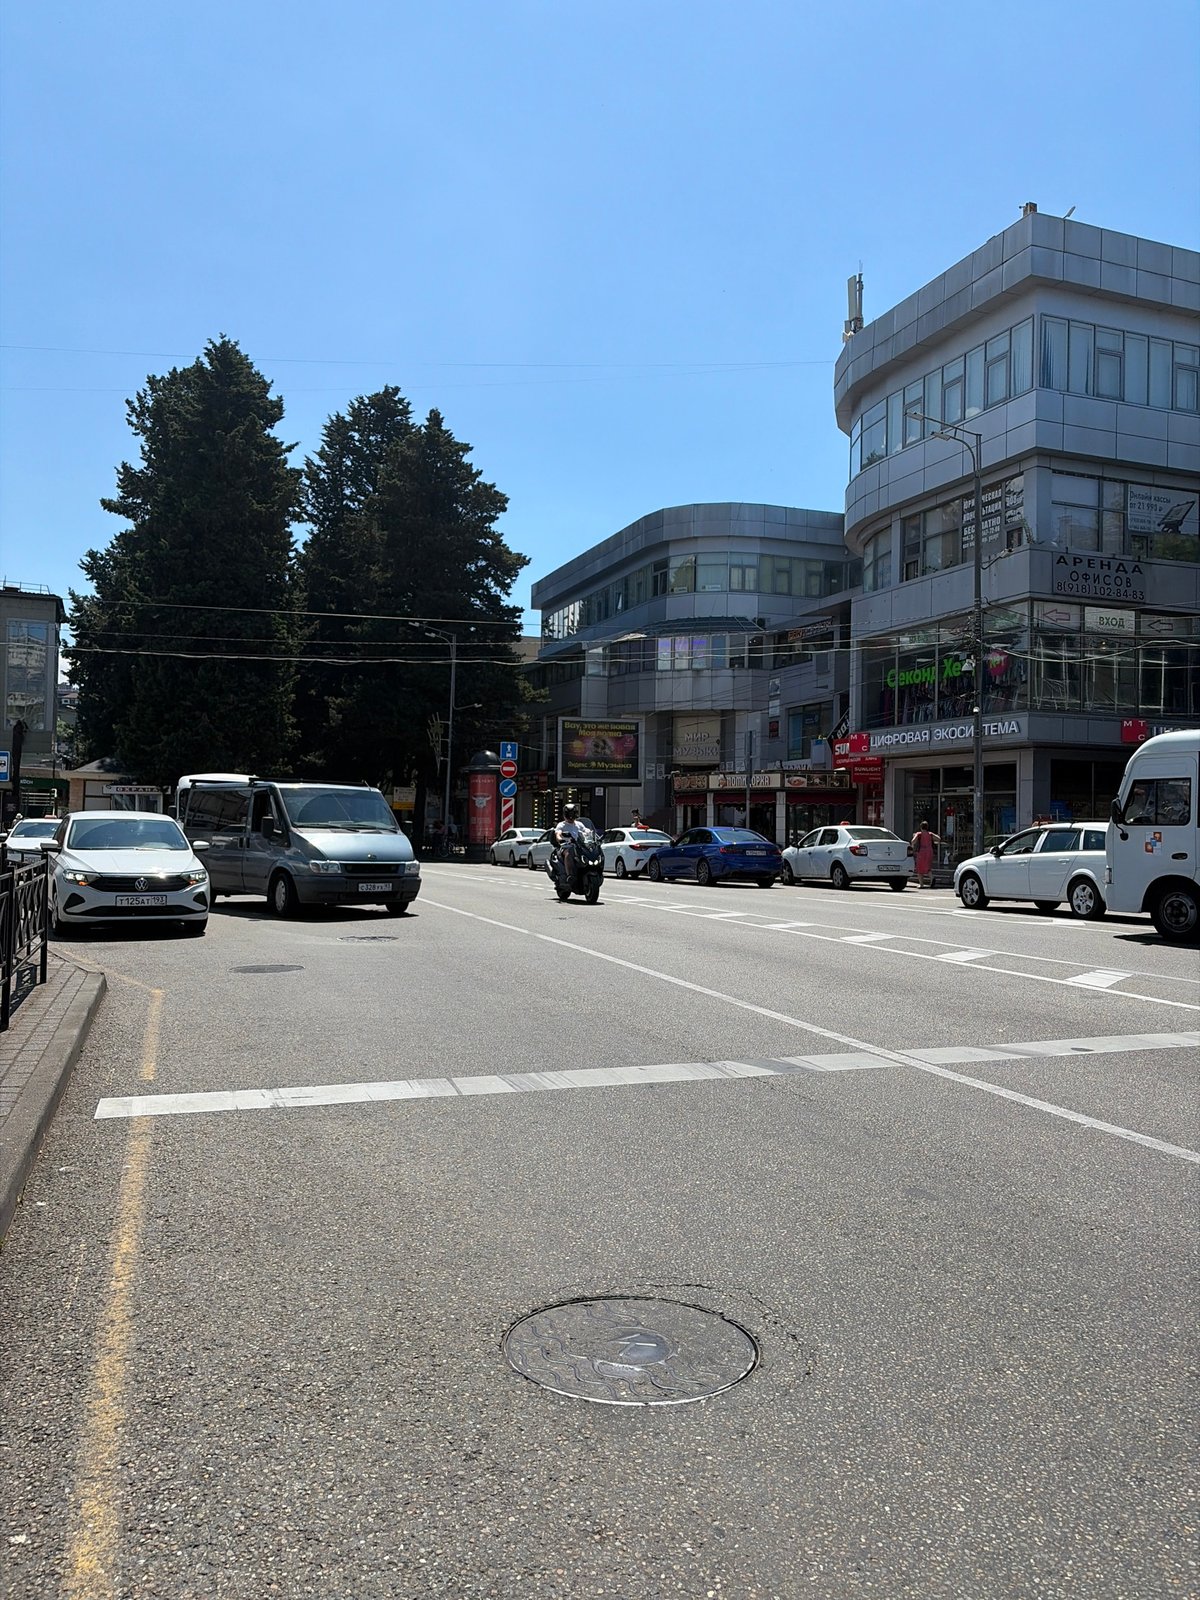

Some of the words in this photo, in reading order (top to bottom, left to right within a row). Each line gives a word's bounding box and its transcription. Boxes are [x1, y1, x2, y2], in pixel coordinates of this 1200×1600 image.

[963, 489, 1002, 511] ЮРИЧЕСКАЯ
[1056, 555, 1143, 575] АРЕНДА
[1070, 570, 1132, 588] ОФИСОВ
[1099, 616, 1125, 629] ВХОД
[564, 721, 582, 731] Вау,
[684, 732, 710, 742] МИР
[870, 730, 930, 748] ЦИФРОВАЯ
[933, 720, 1019, 741] ЭКОСИТЕМА
[568, 761, 588, 769] Яндекс
[597, 761, 632, 770] Музыка
